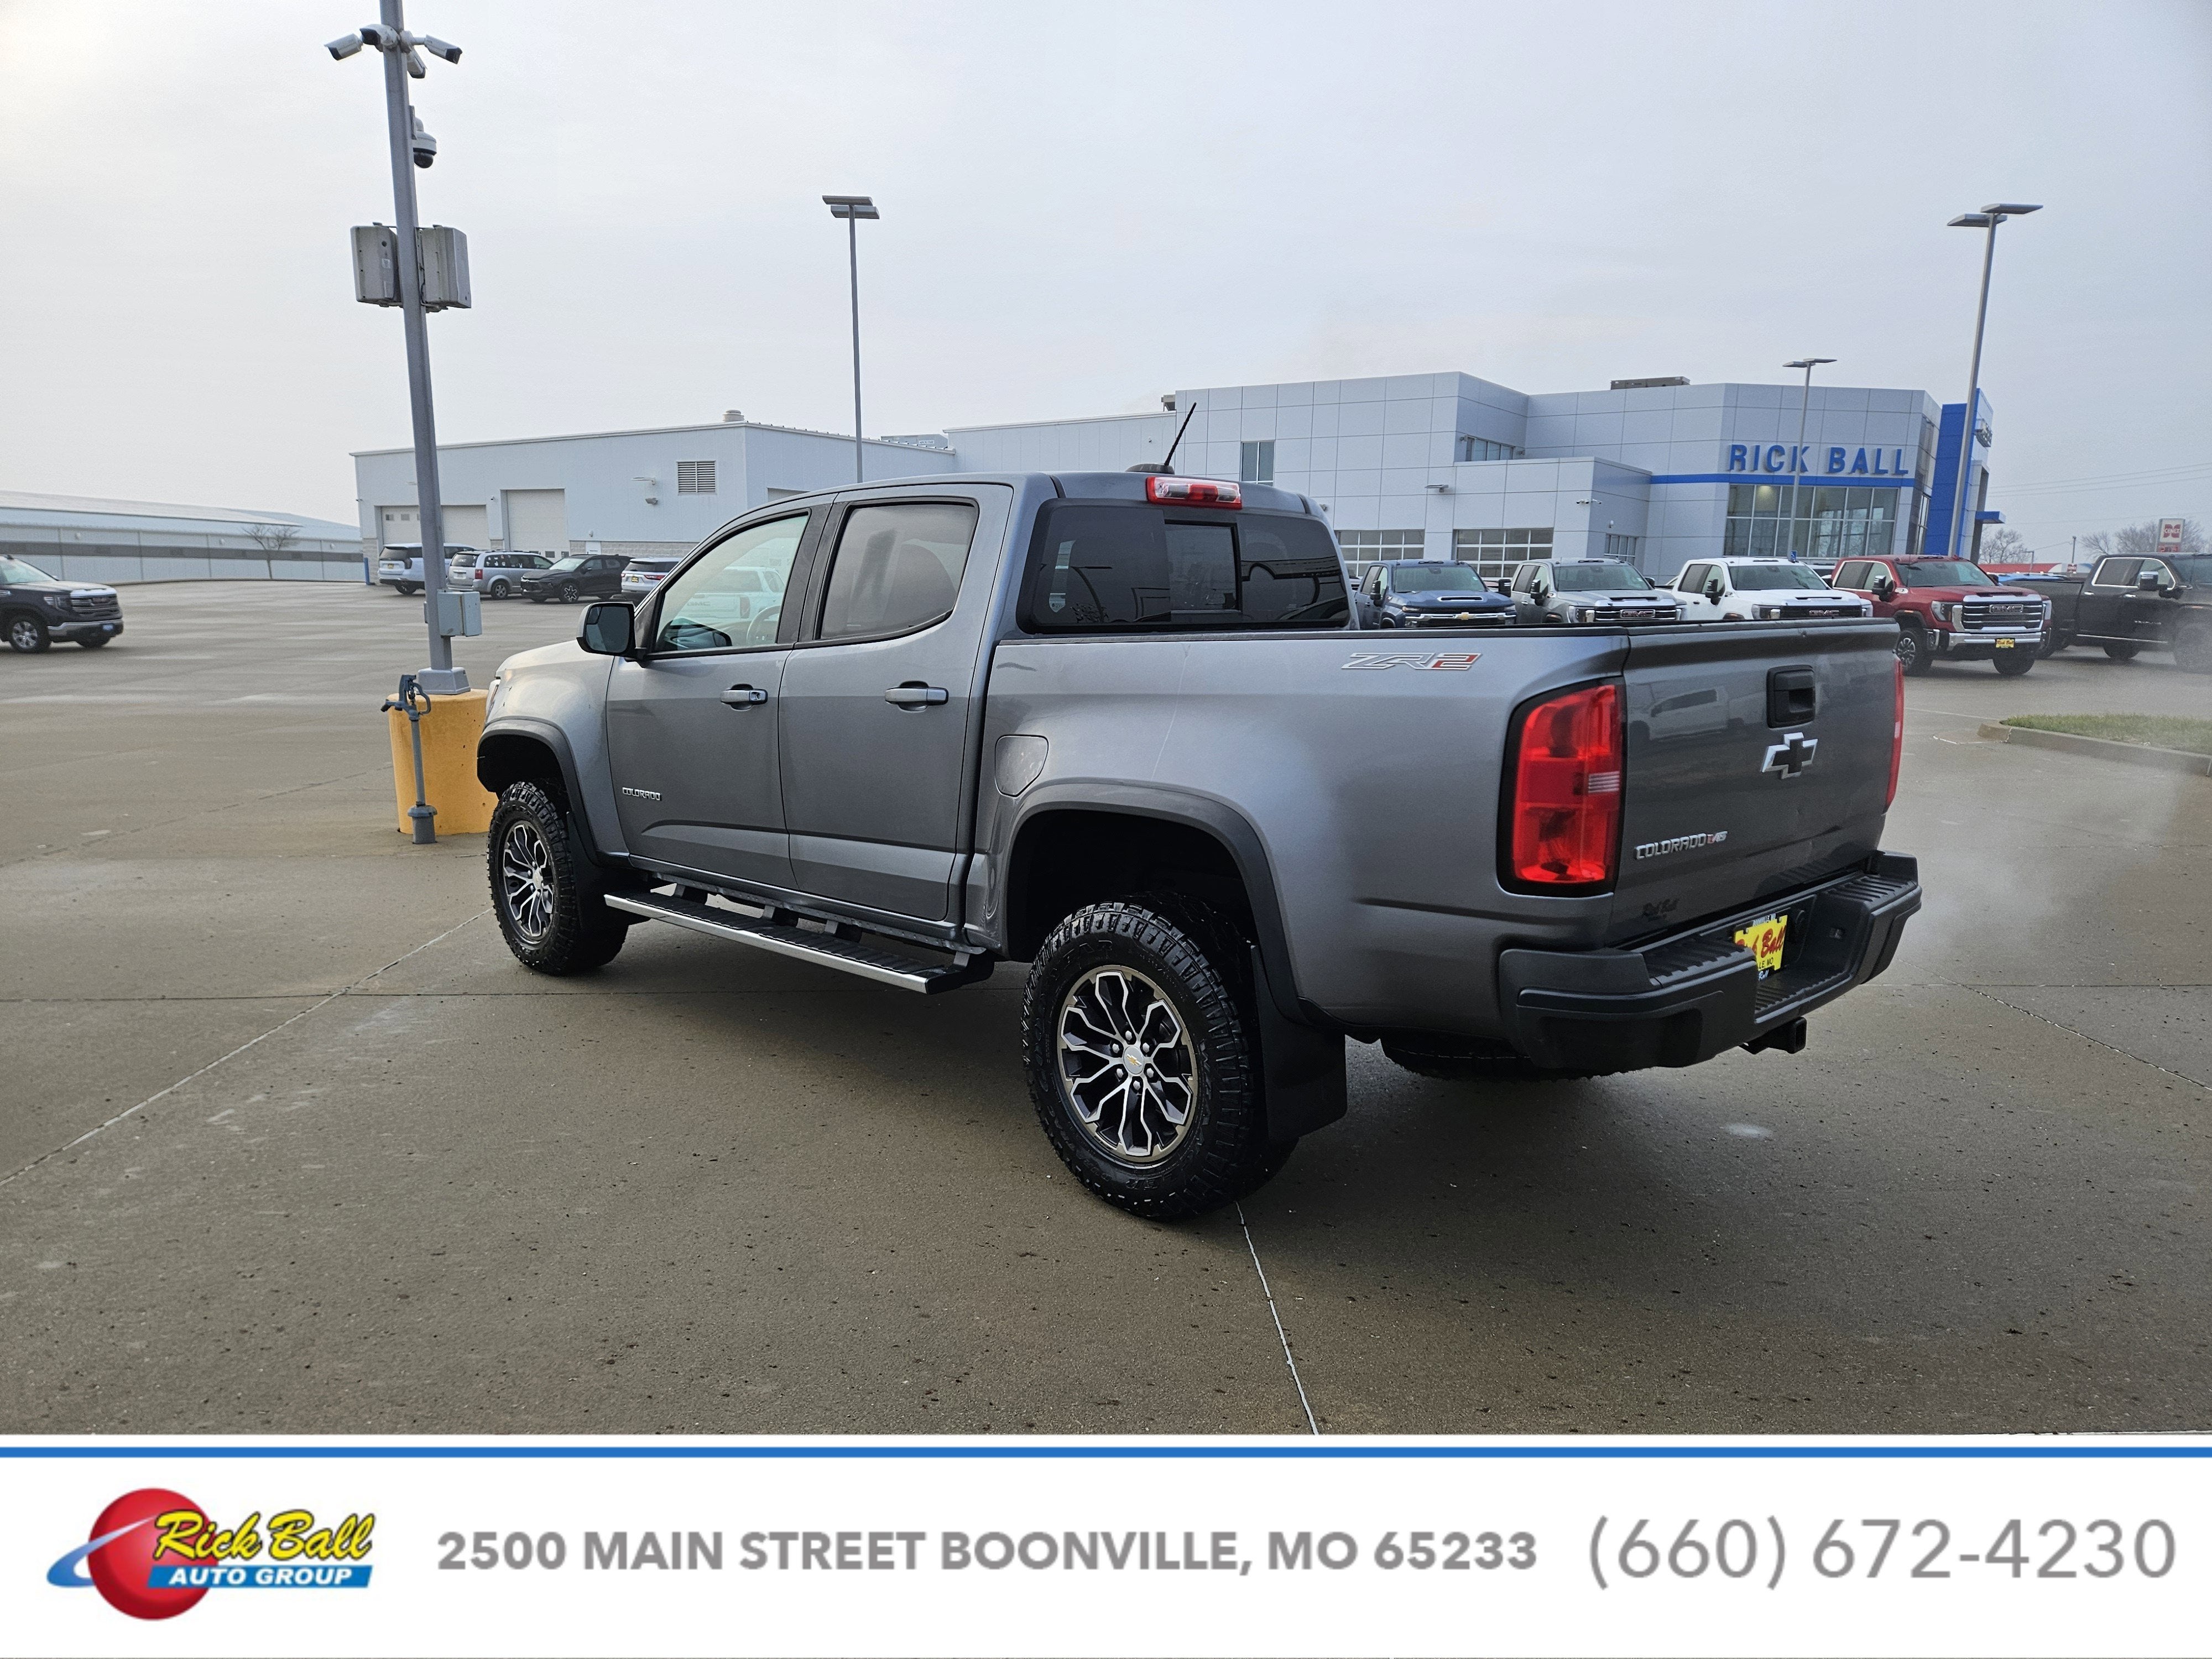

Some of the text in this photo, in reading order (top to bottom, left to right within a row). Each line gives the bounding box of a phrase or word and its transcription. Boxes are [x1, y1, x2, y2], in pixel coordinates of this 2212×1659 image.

[1729, 444, 1909, 475] RICK BALL
[1992, 604, 2023, 613] GMC
[1341, 653, 1482, 670] ZR2
[622, 787, 661, 801] COLORADO
[1635, 833, 1707, 860] COLORADO
[1761, 925, 1787, 958] Ball
